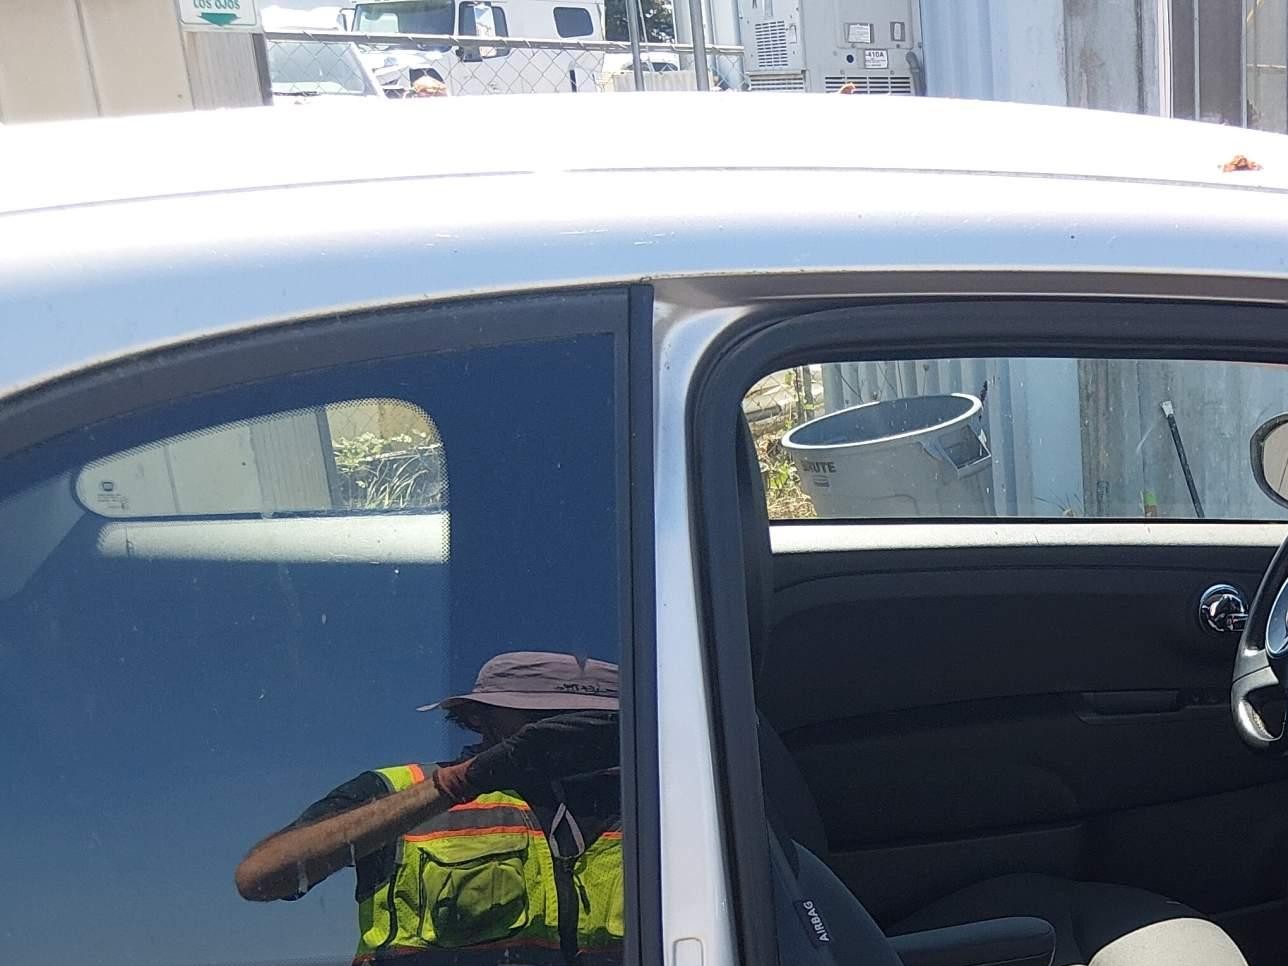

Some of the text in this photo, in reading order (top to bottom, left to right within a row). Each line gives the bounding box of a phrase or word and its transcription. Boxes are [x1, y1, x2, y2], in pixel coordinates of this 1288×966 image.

[193, 0, 241, 9] LOS OJOS
[803, 900, 830, 941] AIRBAG
